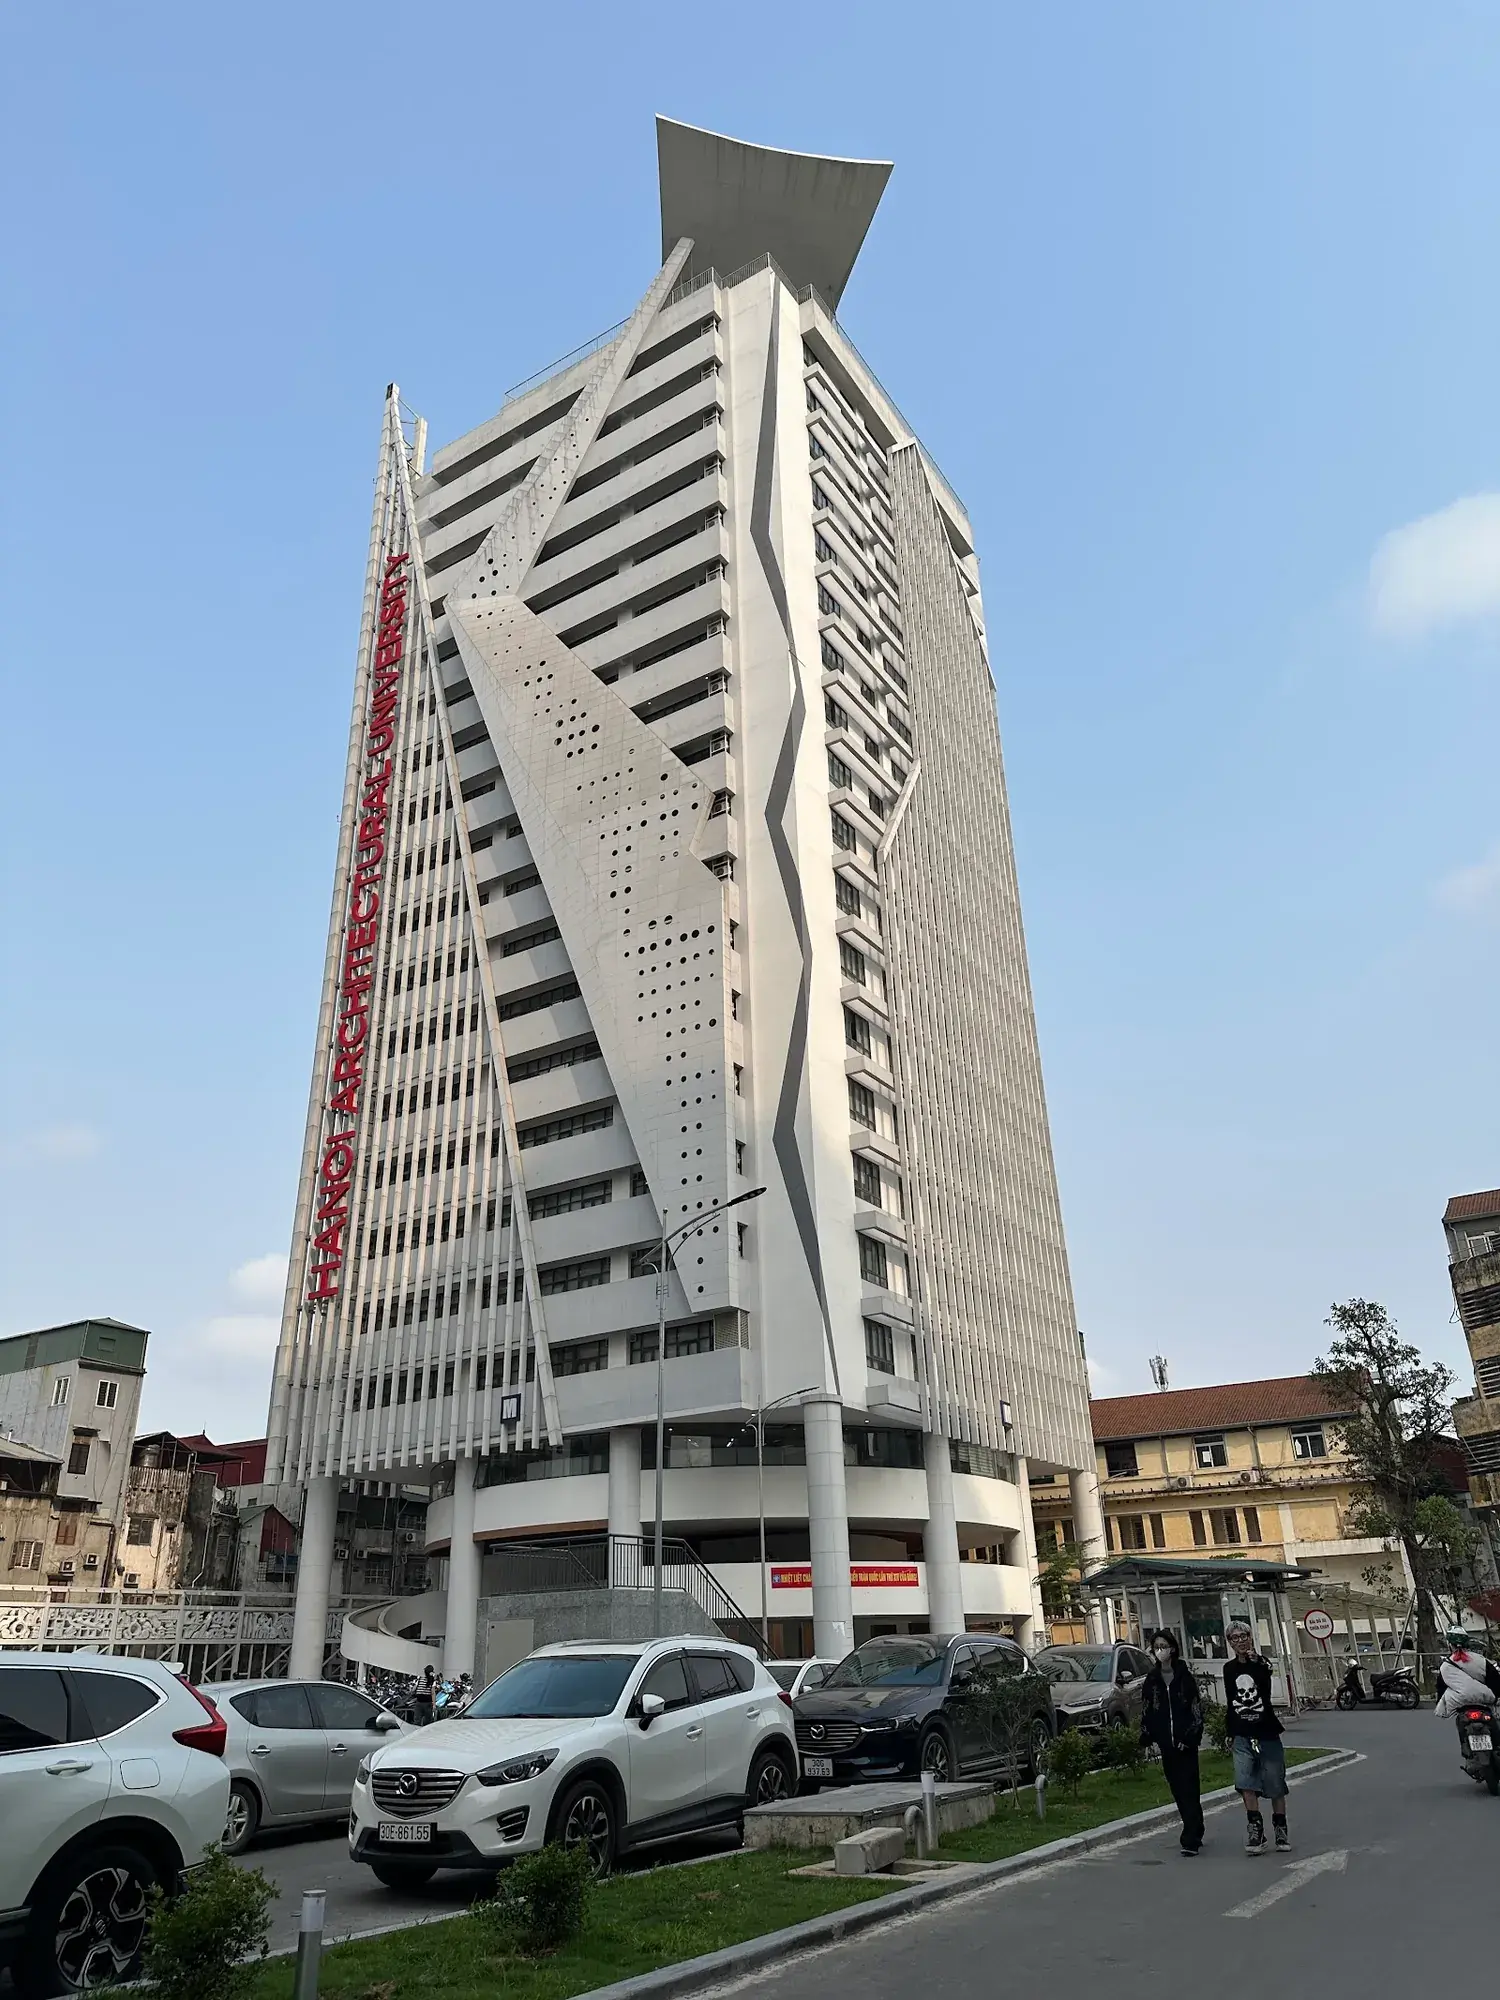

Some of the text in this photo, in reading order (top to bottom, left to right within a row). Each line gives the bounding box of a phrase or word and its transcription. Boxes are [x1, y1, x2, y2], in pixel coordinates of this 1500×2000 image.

[308, 551, 409, 1300] HANOI ARCHITECTURAL UNIVERSITY
[381, 1825, 429, 1840] 30E-861.55
